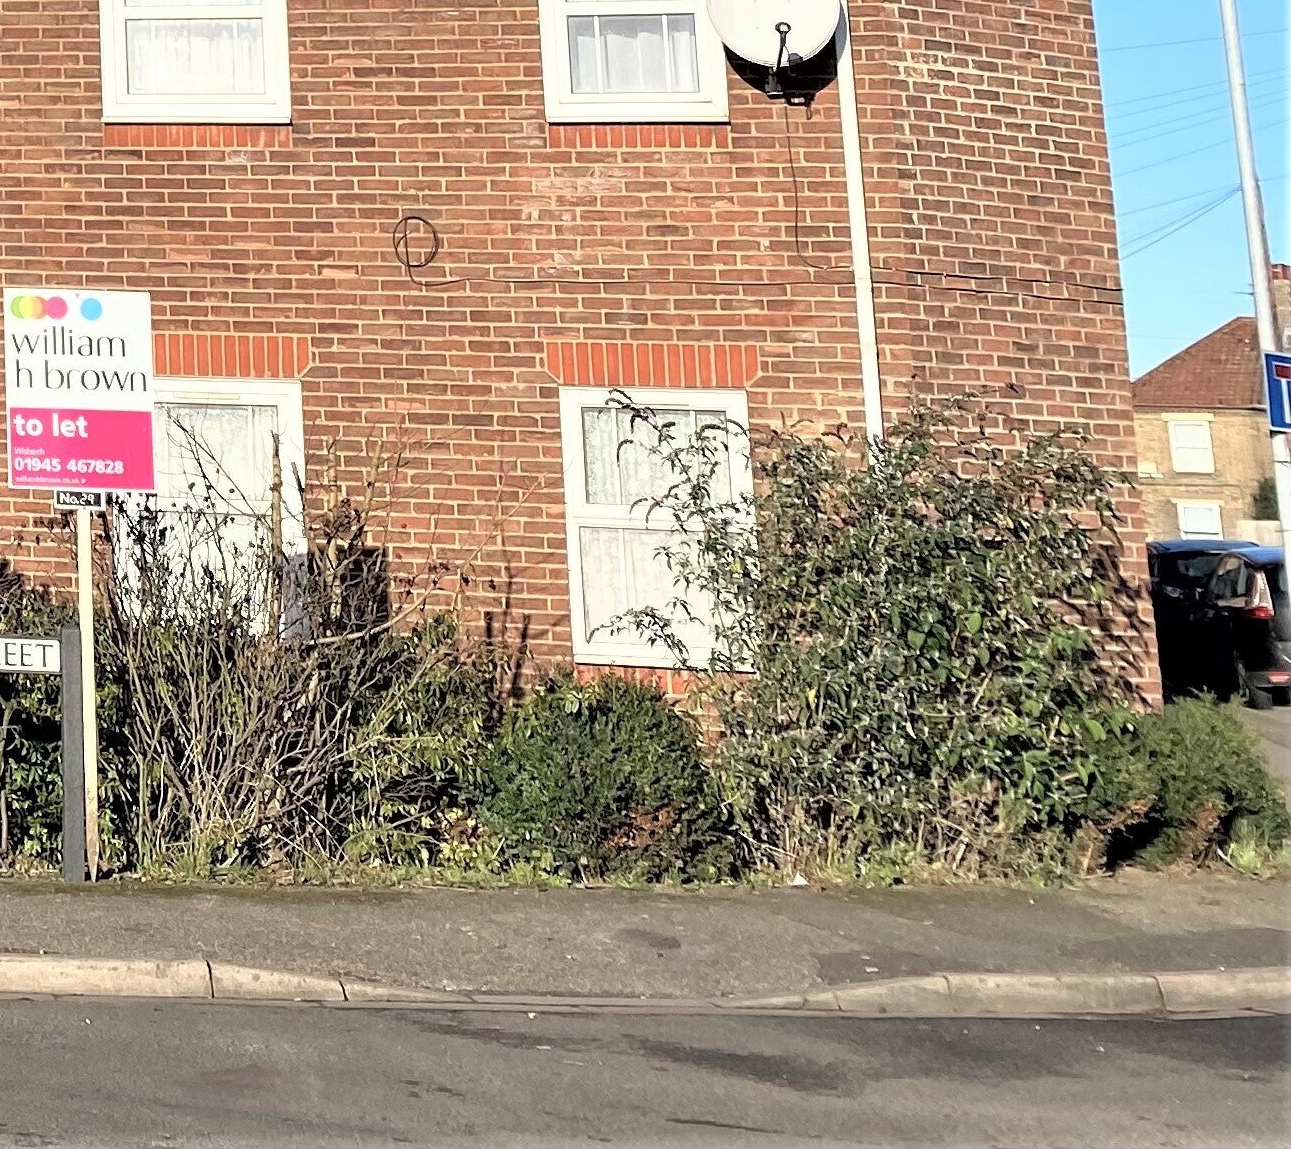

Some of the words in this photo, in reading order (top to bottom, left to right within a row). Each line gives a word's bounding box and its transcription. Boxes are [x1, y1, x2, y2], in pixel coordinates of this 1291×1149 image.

[11, 326, 126, 357] william
[16, 359, 33, 388] h
[44, 360, 147, 392] brown
[14, 414, 44, 437] to
[52, 413, 89, 438] let
[14, 457, 62, 473] 01945
[66, 459, 125, 475] 467828
